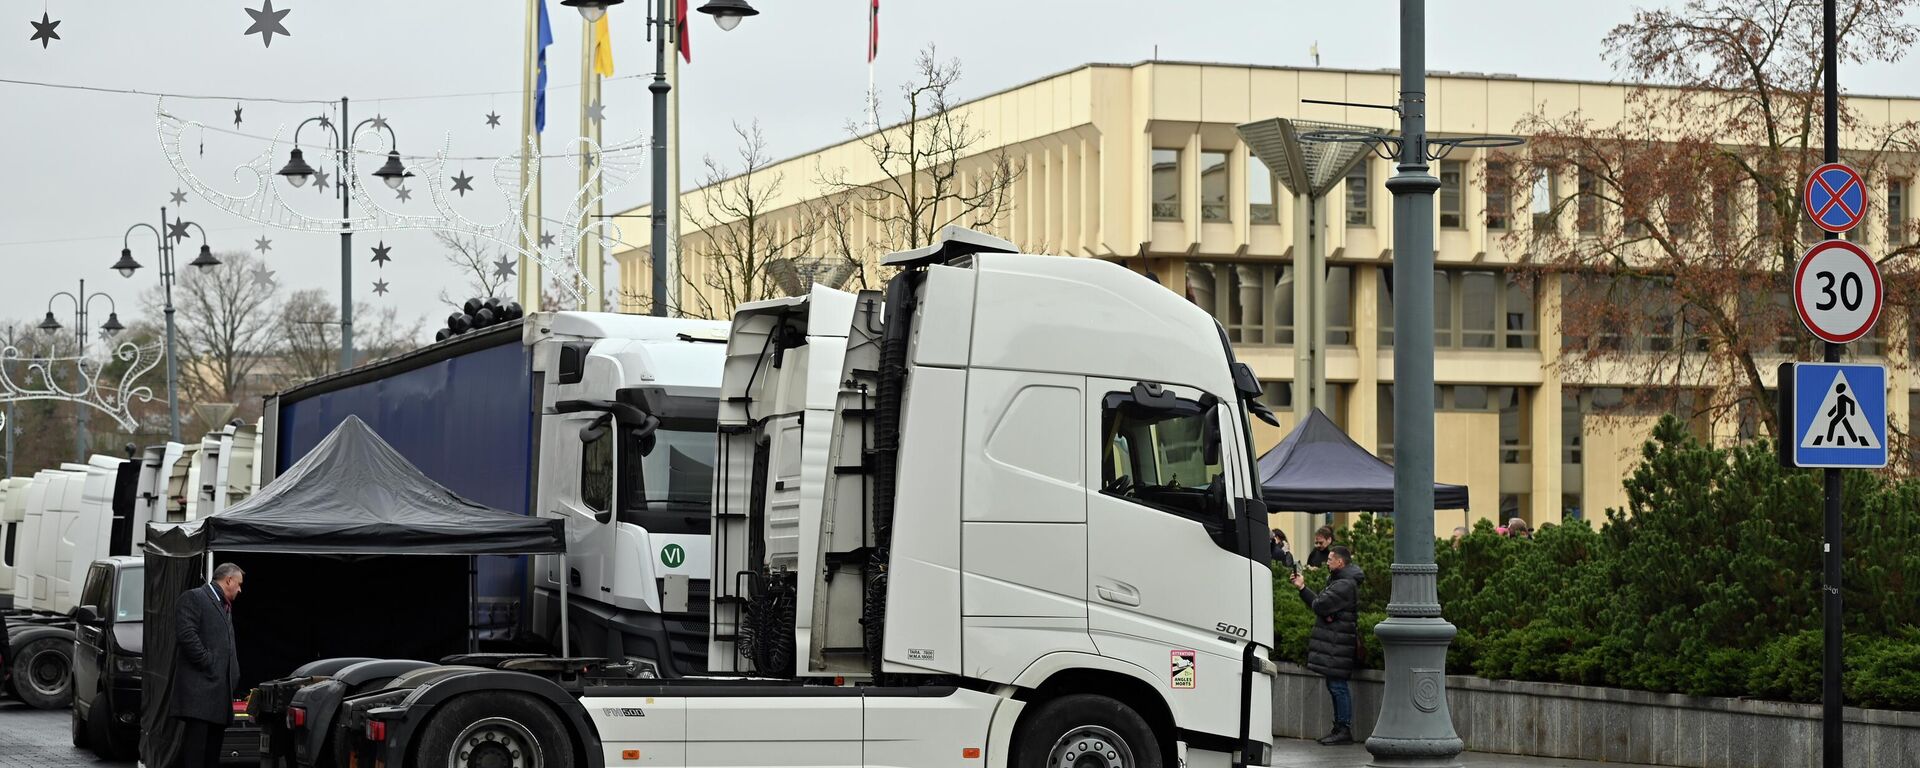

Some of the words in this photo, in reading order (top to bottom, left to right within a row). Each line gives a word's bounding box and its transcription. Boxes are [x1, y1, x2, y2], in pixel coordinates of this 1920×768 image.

[1816, 271, 1863, 311] 30
[664, 548, 681, 564] VI
[1216, 622, 1248, 637] 500
